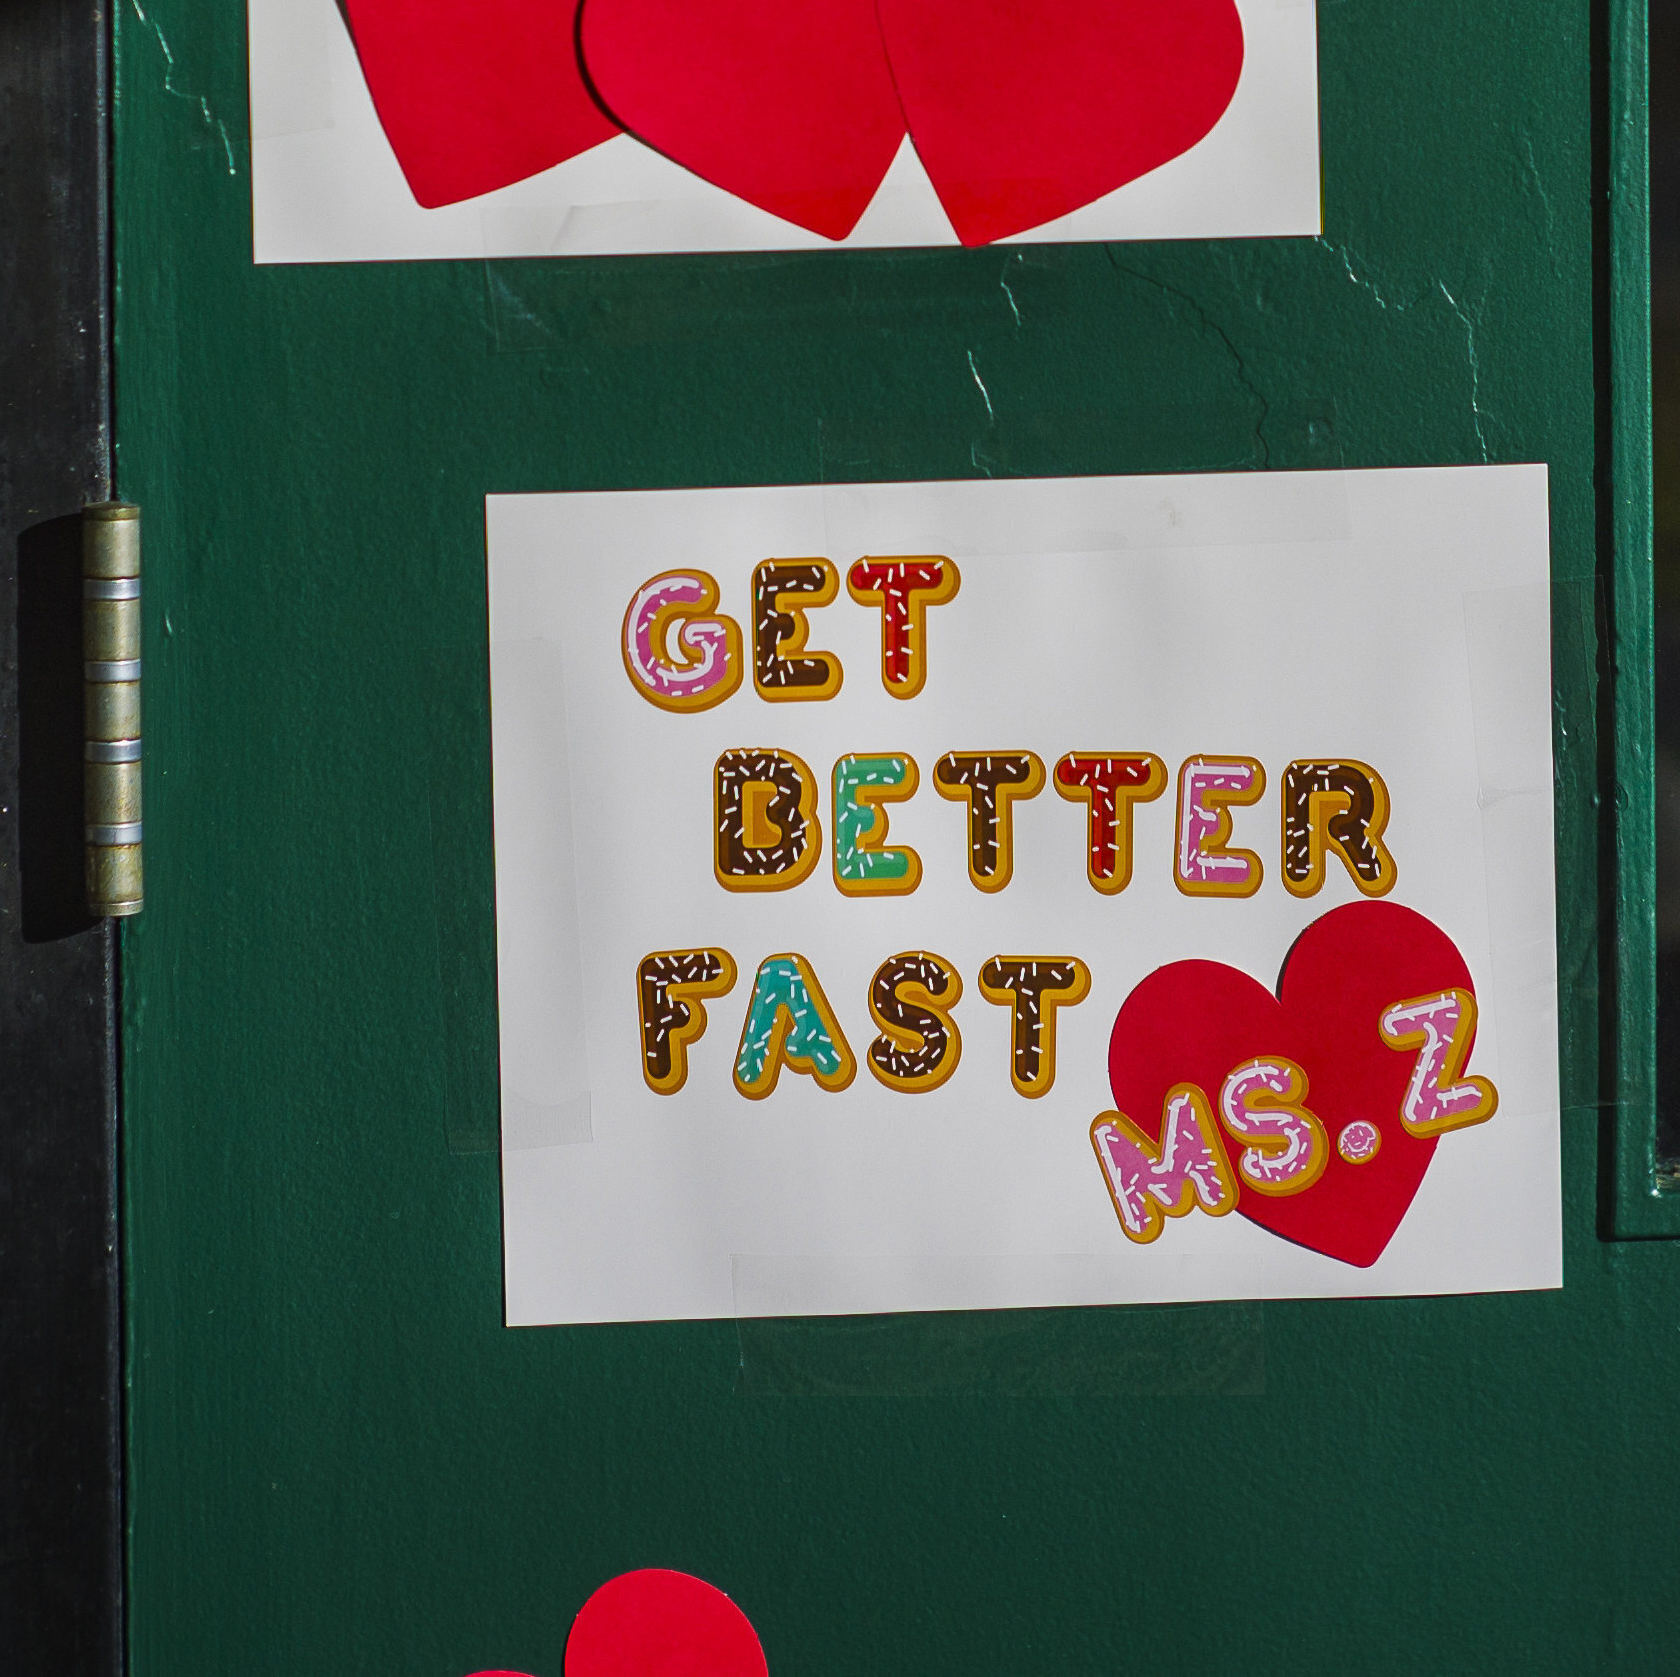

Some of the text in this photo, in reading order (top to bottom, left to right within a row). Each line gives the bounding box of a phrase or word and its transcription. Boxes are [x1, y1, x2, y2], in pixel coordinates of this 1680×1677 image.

[620, 555, 961, 714] GET
[711, 747, 1398, 898] BETTER
[635, 946, 1092, 1100] FAST
